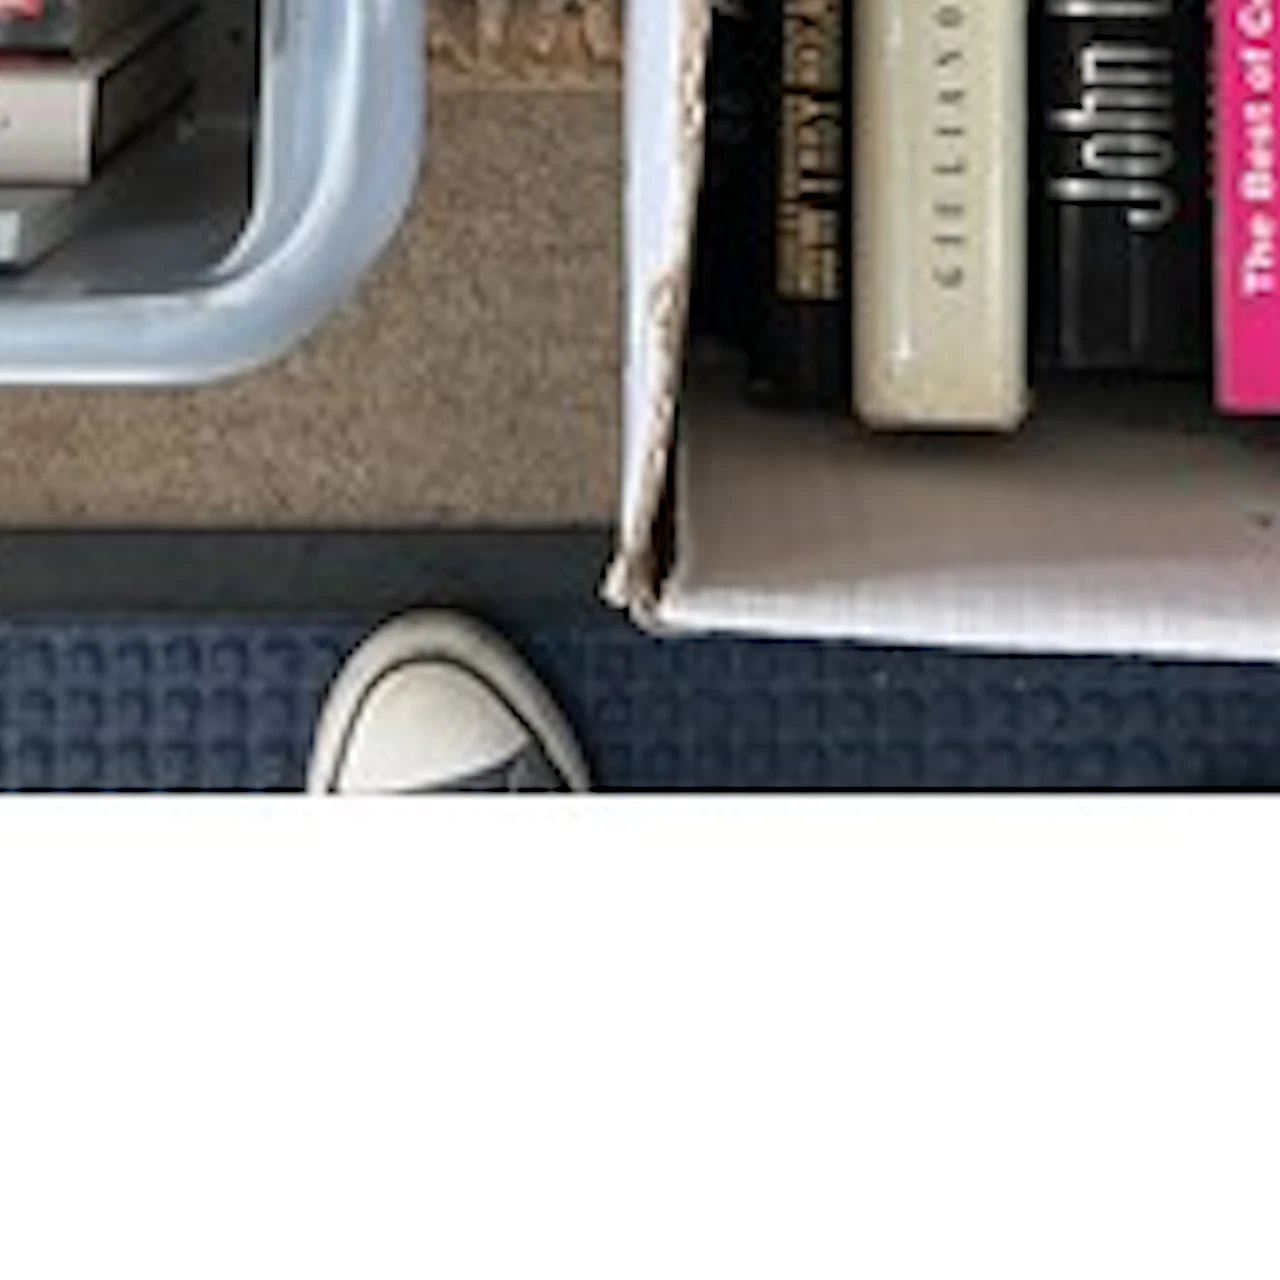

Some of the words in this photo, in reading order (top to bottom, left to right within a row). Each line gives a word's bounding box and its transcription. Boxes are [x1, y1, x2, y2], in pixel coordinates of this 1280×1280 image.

[1237, 50, 1272, 91] of
[1047, 42, 1176, 228] John
[1238, 101, 1274, 203] Best
[1240, 218, 1275, 298] The
